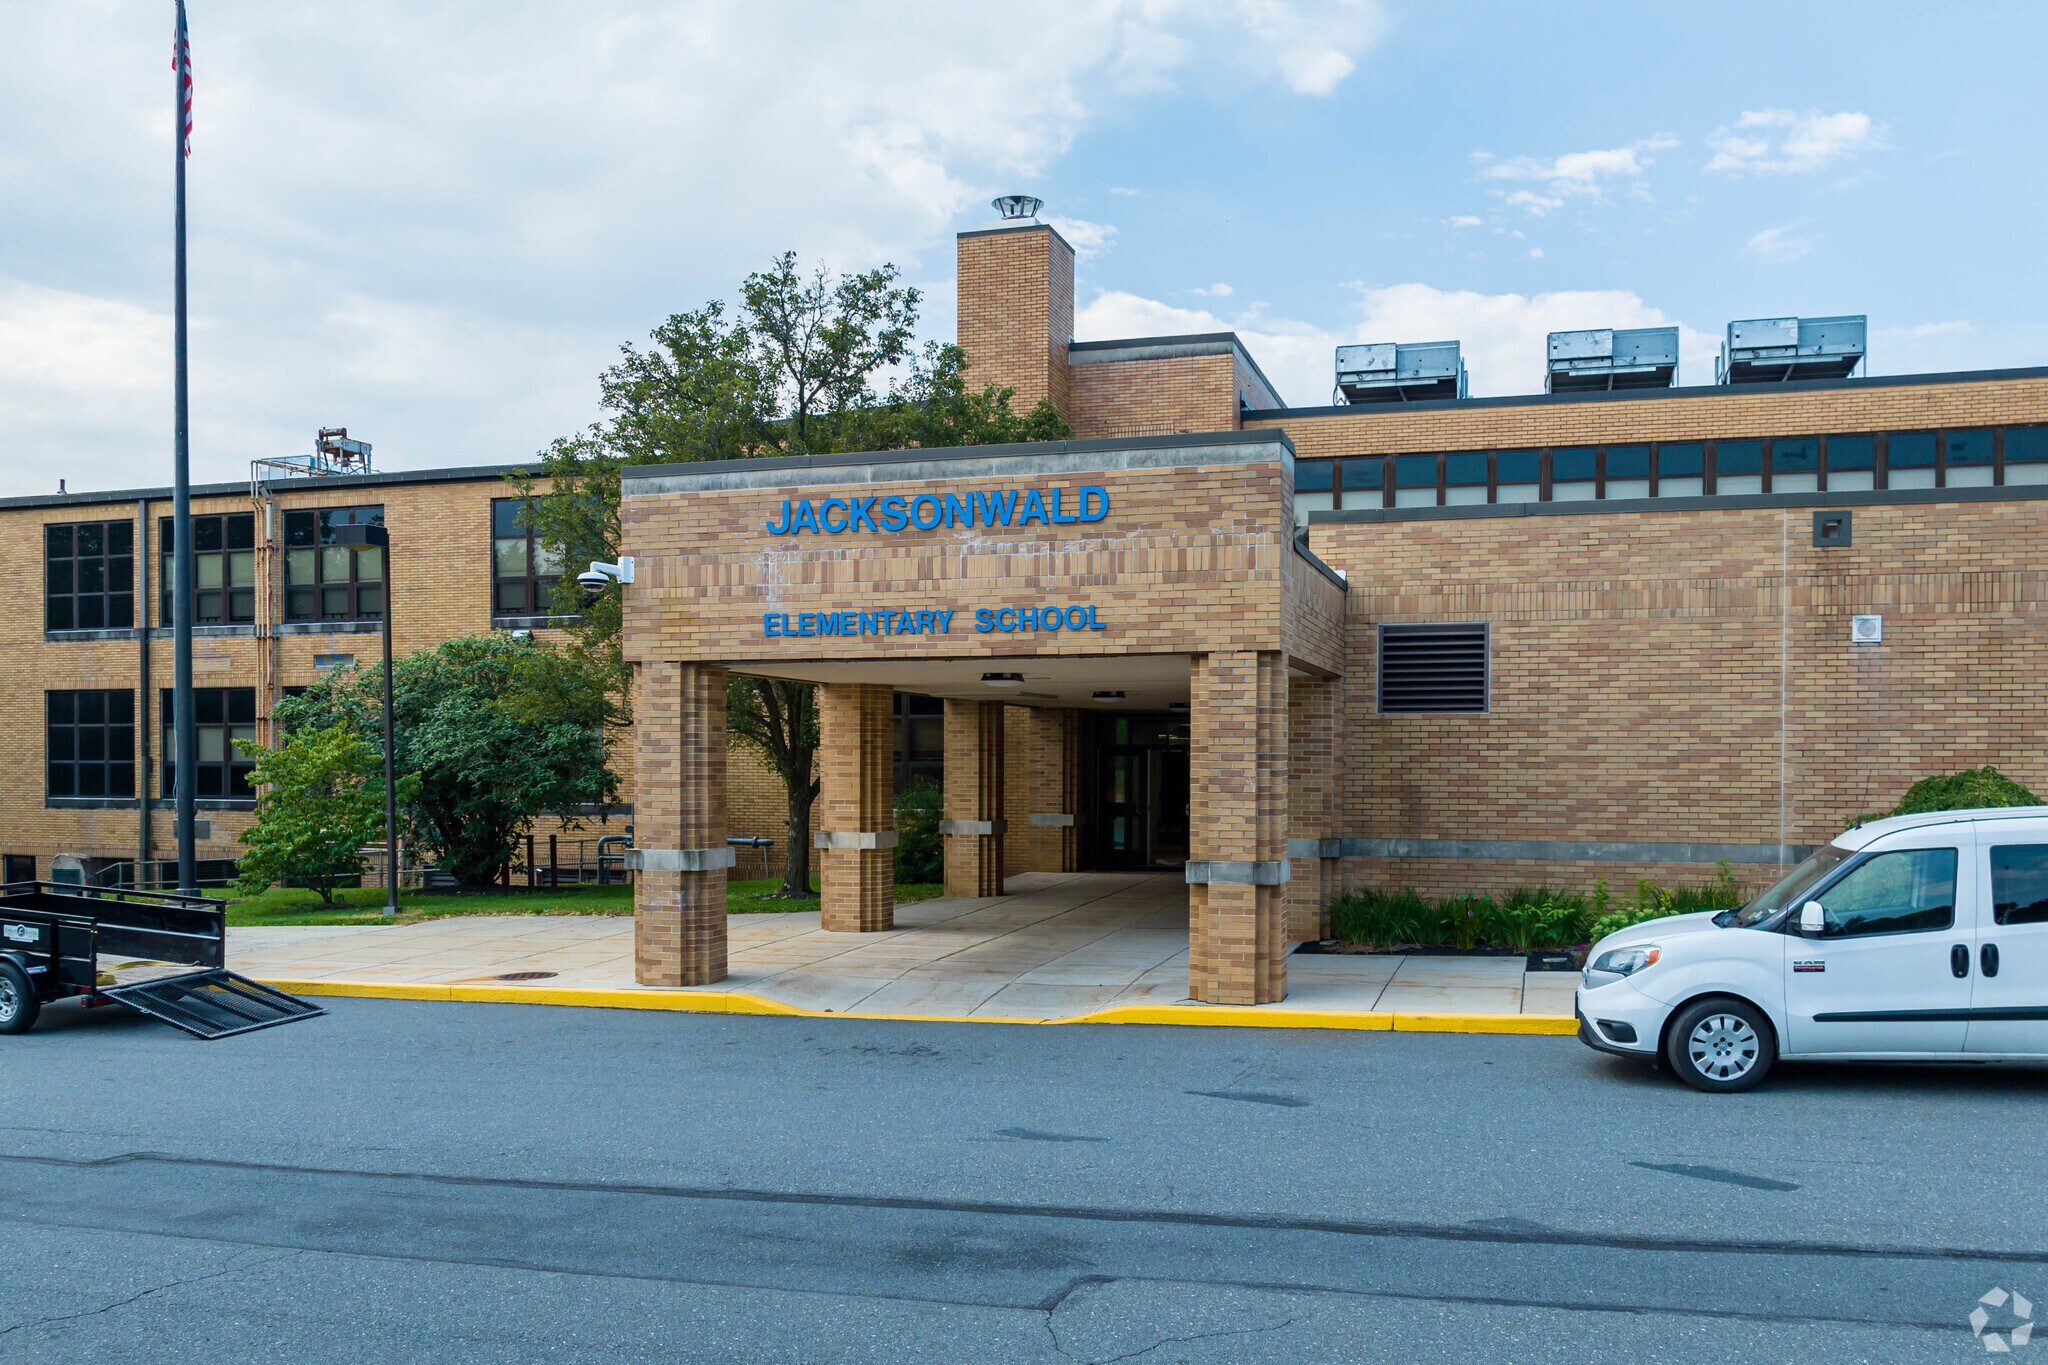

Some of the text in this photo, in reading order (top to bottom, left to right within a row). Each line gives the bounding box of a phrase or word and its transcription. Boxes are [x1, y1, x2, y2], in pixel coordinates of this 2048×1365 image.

[766, 486, 1110, 535] JACKSONWALD
[763, 605, 1106, 637] ELEMENTARY SCHOOL
